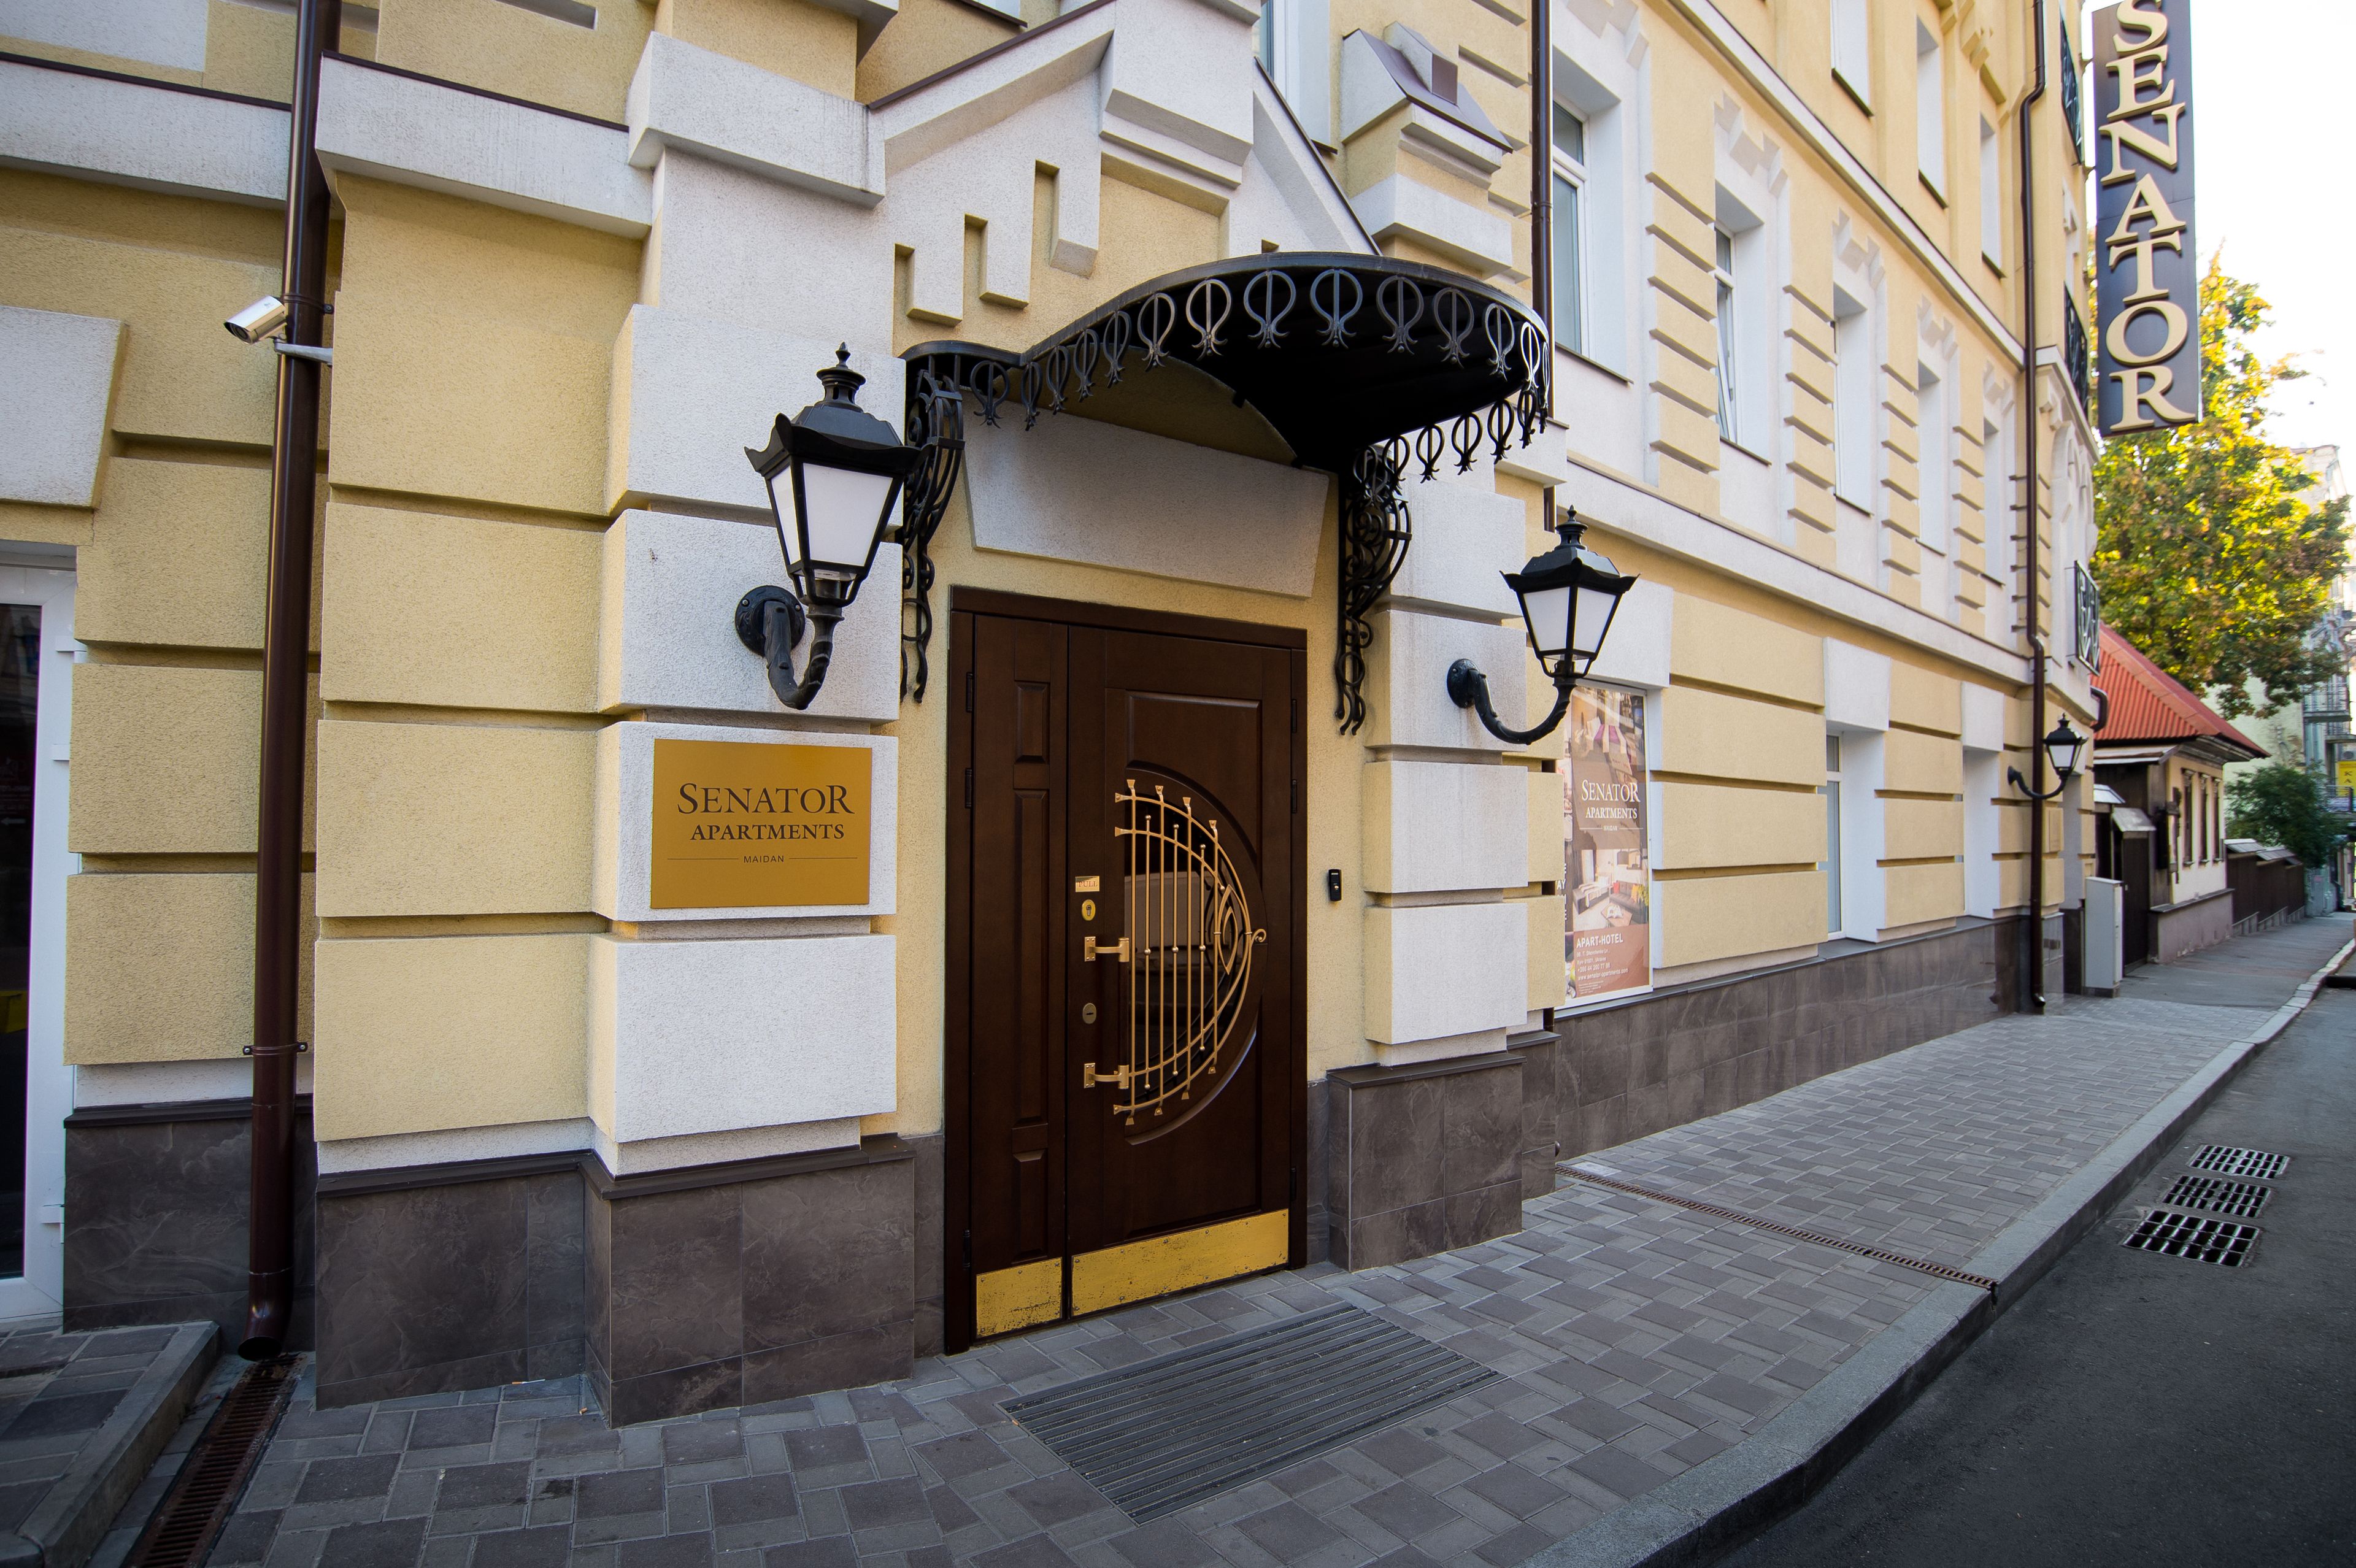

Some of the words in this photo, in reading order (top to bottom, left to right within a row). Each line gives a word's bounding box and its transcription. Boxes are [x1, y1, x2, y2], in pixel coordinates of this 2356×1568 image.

[2098, 0, 2196, 429] SENATOR
[677, 783, 855, 815] SENATOR
[1581, 779, 1641, 802] SENATOR
[1585, 807, 1638, 819] APARTMENTS
[689, 824, 845, 840] APARTMENTS
[1576, 933, 1623, 948] APART-HOTEL
